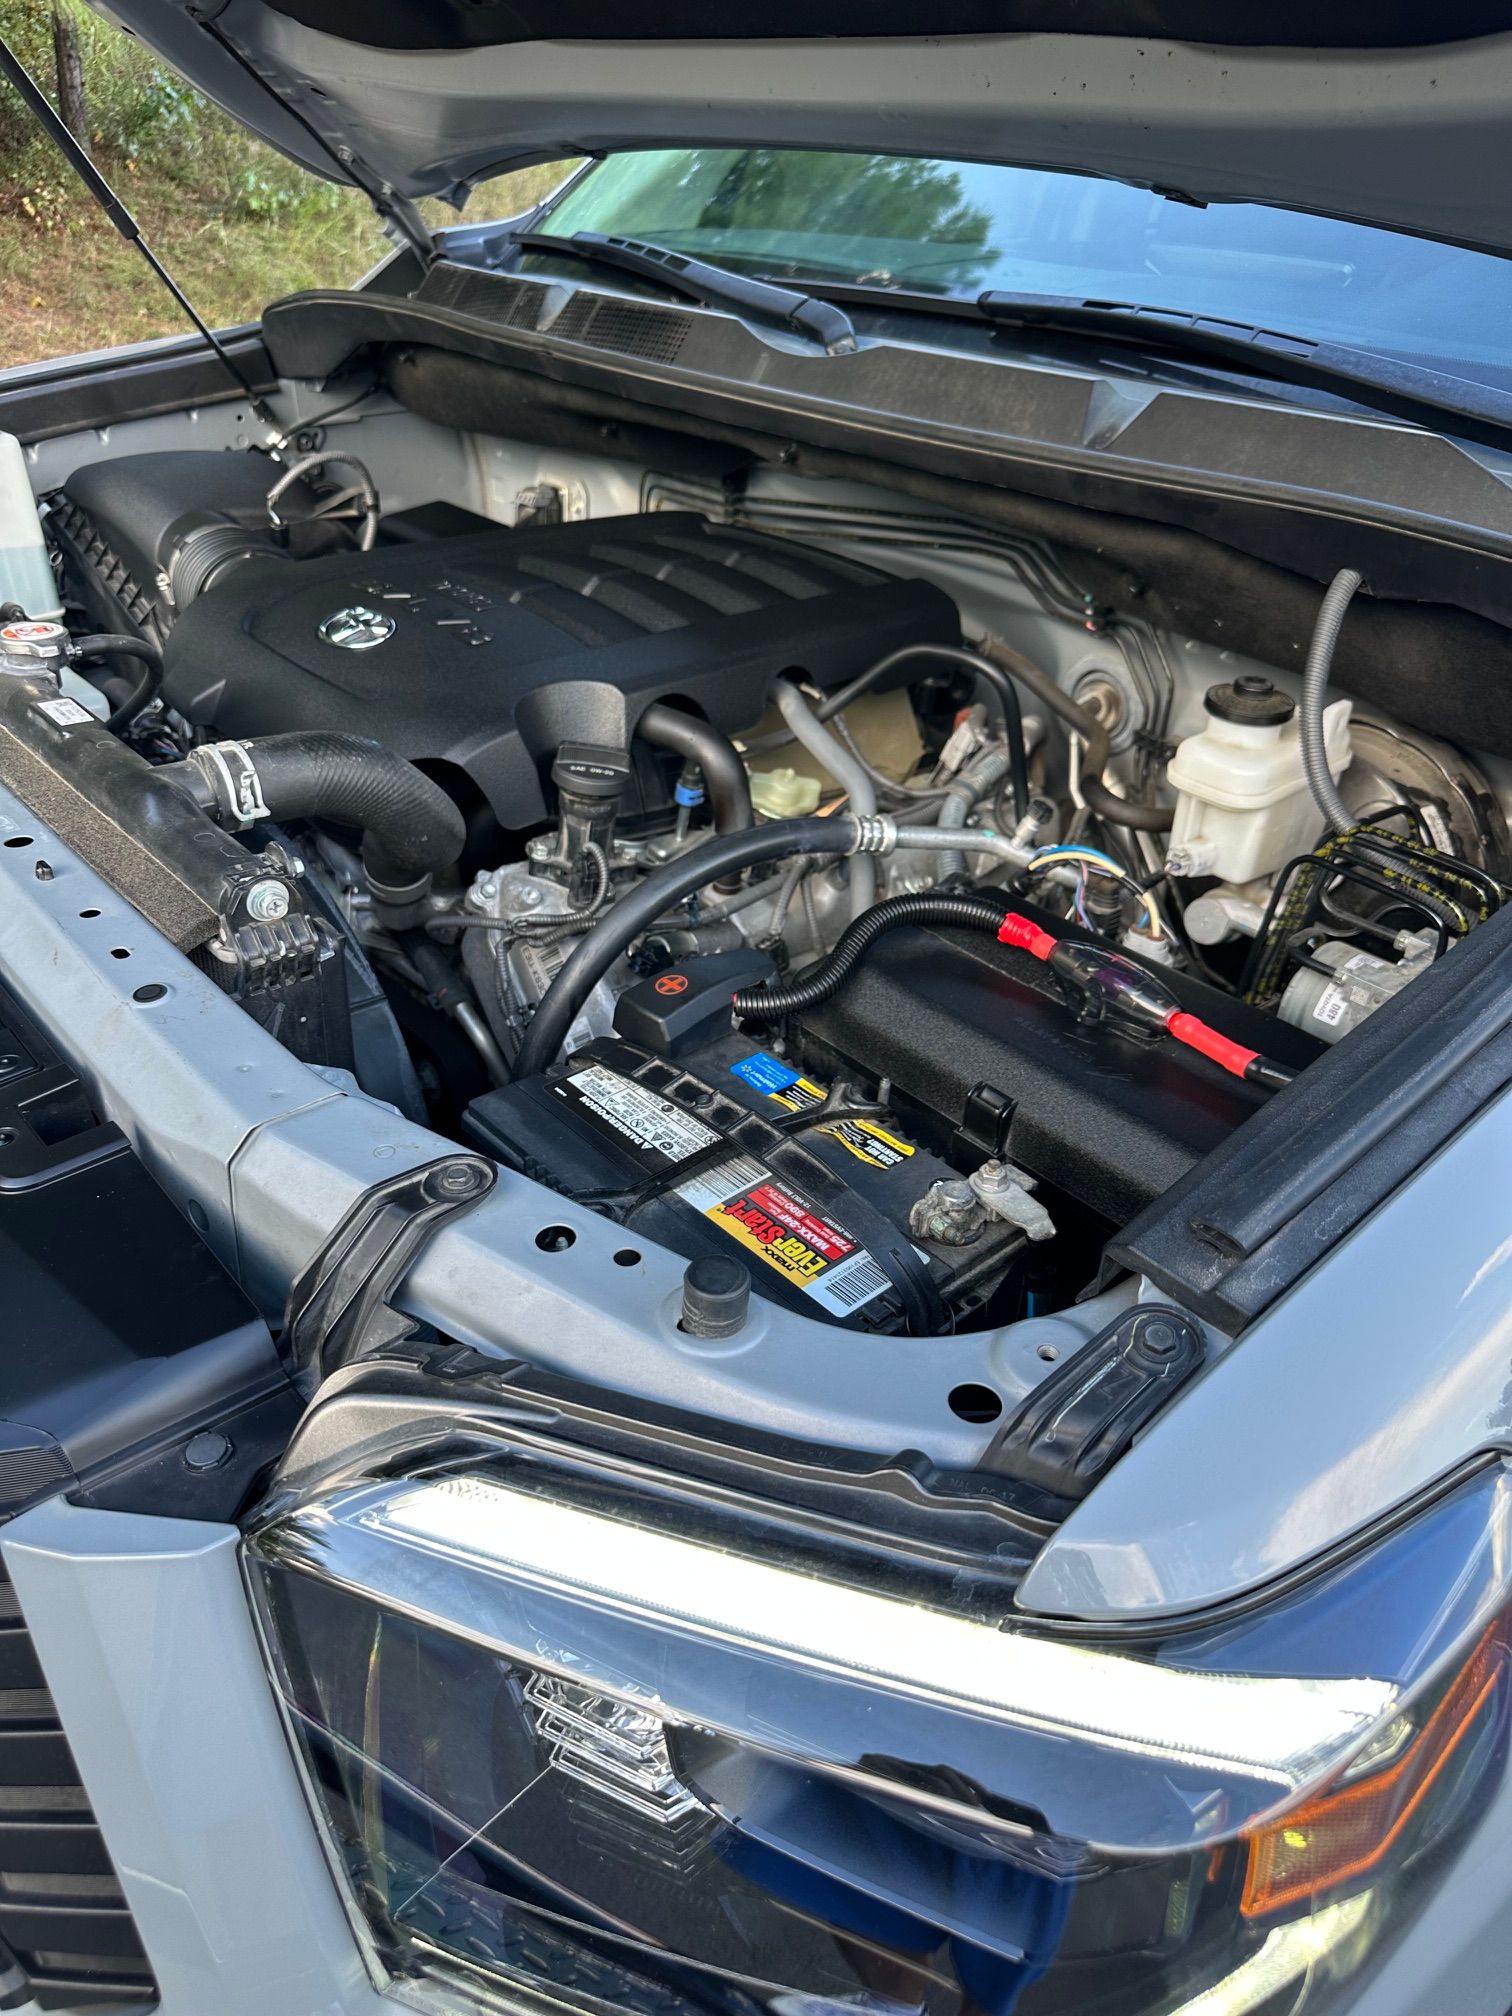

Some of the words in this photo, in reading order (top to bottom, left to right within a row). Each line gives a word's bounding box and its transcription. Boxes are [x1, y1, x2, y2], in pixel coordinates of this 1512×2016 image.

[1317, 992, 1332, 1016] TOYOTA
[1326, 1002, 1341, 1021] 480
[750, 1070, 777, 1090] Walmart
[579, 1096, 644, 1145] DANGER/POISON
[863, 1145, 881, 1156] NOT
[865, 1138, 904, 1162] STARTING?
[876, 1153, 895, 1165] CAR
[782, 1201, 806, 1217] 890
[723, 1198, 829, 1278] EverStart
[776, 1211, 830, 1250] MAXX-24F
[828, 1234, 852, 1251] 725
[760, 1245, 795, 1271] maxx
